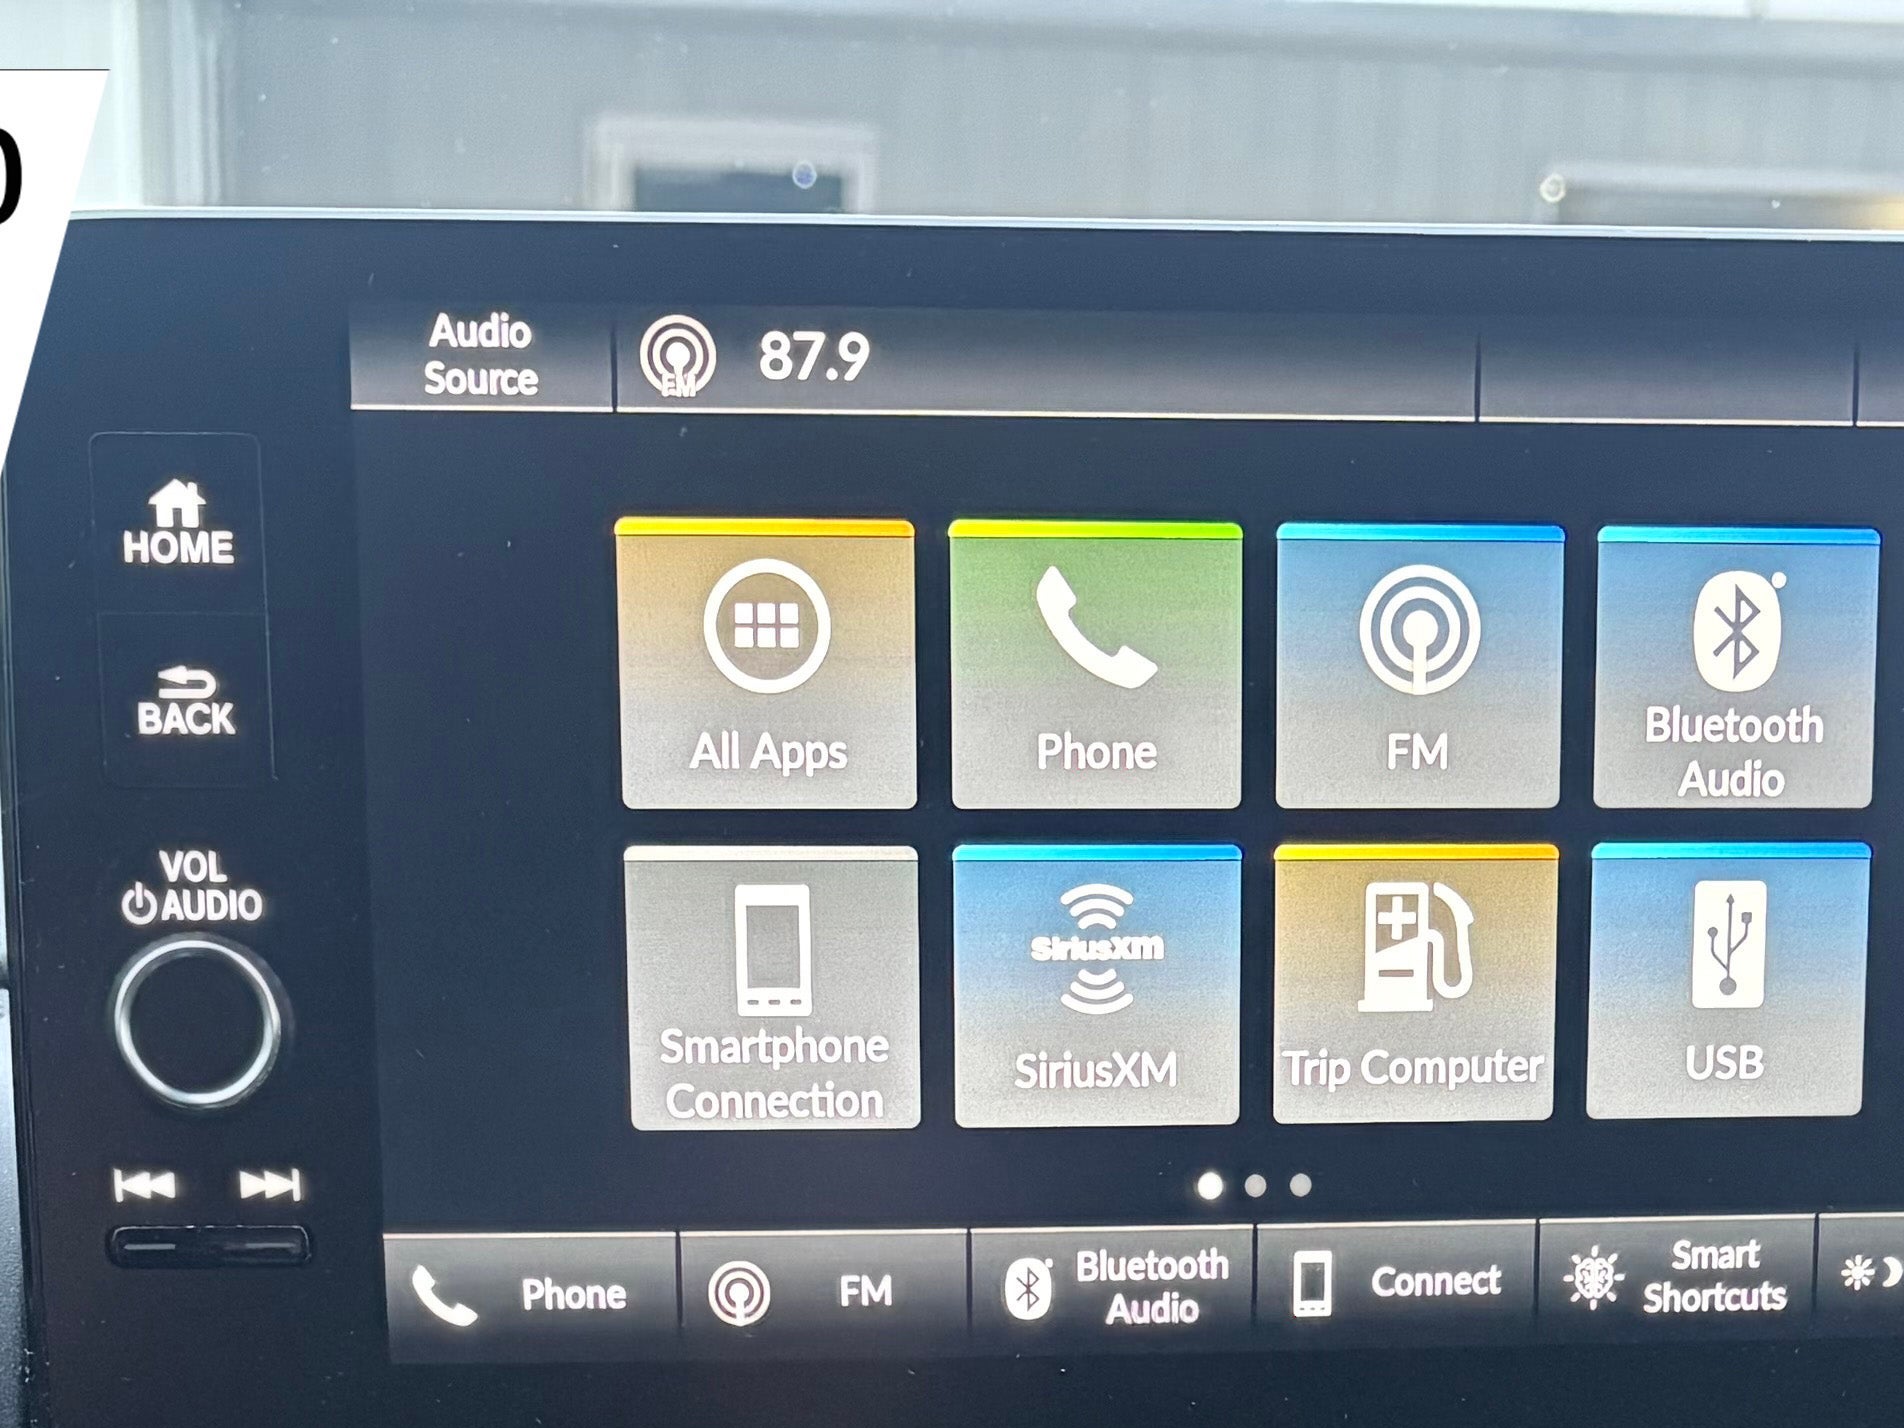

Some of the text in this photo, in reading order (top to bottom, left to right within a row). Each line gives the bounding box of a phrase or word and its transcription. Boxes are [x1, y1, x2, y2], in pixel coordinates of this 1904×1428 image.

[428, 311, 533, 349] Audio
[759, 330, 870, 382] 87.9
[424, 360, 539, 396] Source
[123, 530, 235, 564] HOME
[137, 702, 236, 735] BACK
[1646, 704, 1824, 744] Bluetooth
[688, 729, 848, 778] All Apps
[1038, 729, 1158, 770] Phone
[1387, 732, 1448, 770] FM
[1678, 760, 1786, 798] Audio
[158, 850, 228, 883] VOL
[161, 888, 263, 921] AUDIO
[660, 1024, 890, 1071] Smartphone
[1686, 1044, 1765, 1081] USB
[1014, 1049, 1177, 1089] SiriusXM
[1281, 1049, 1546, 1093] Trip Computer
[665, 1080, 885, 1119] Connection
[1076, 1246, 1229, 1282] Bluetooth
[1671, 1238, 1762, 1270] Smart
[522, 1276, 627, 1311] Phone
[840, 1273, 893, 1307] FM
[1371, 1264, 1502, 1297] Connect
[1643, 1280, 1788, 1314] Shortcuts
[1105, 1290, 1200, 1325] Audio
